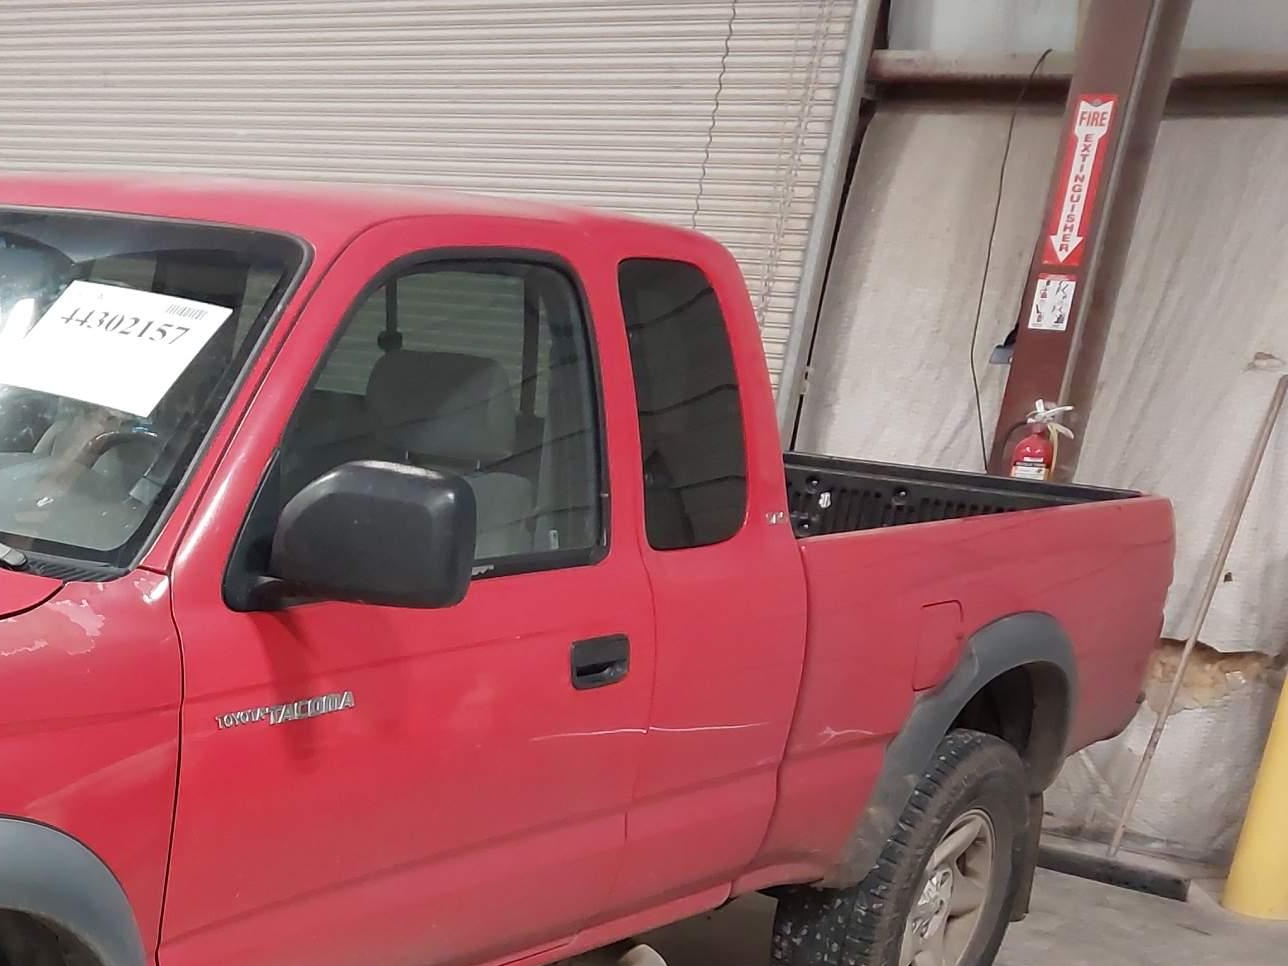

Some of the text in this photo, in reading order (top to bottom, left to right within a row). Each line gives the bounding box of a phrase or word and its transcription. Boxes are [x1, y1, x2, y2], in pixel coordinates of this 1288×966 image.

[1078, 110, 1110, 128] FIRE
[1058, 133, 1095, 253] EXTINGUISHER
[60, 307, 191, 345] 44302157
[215, 691, 355, 729] TOYOTA TACOMA
